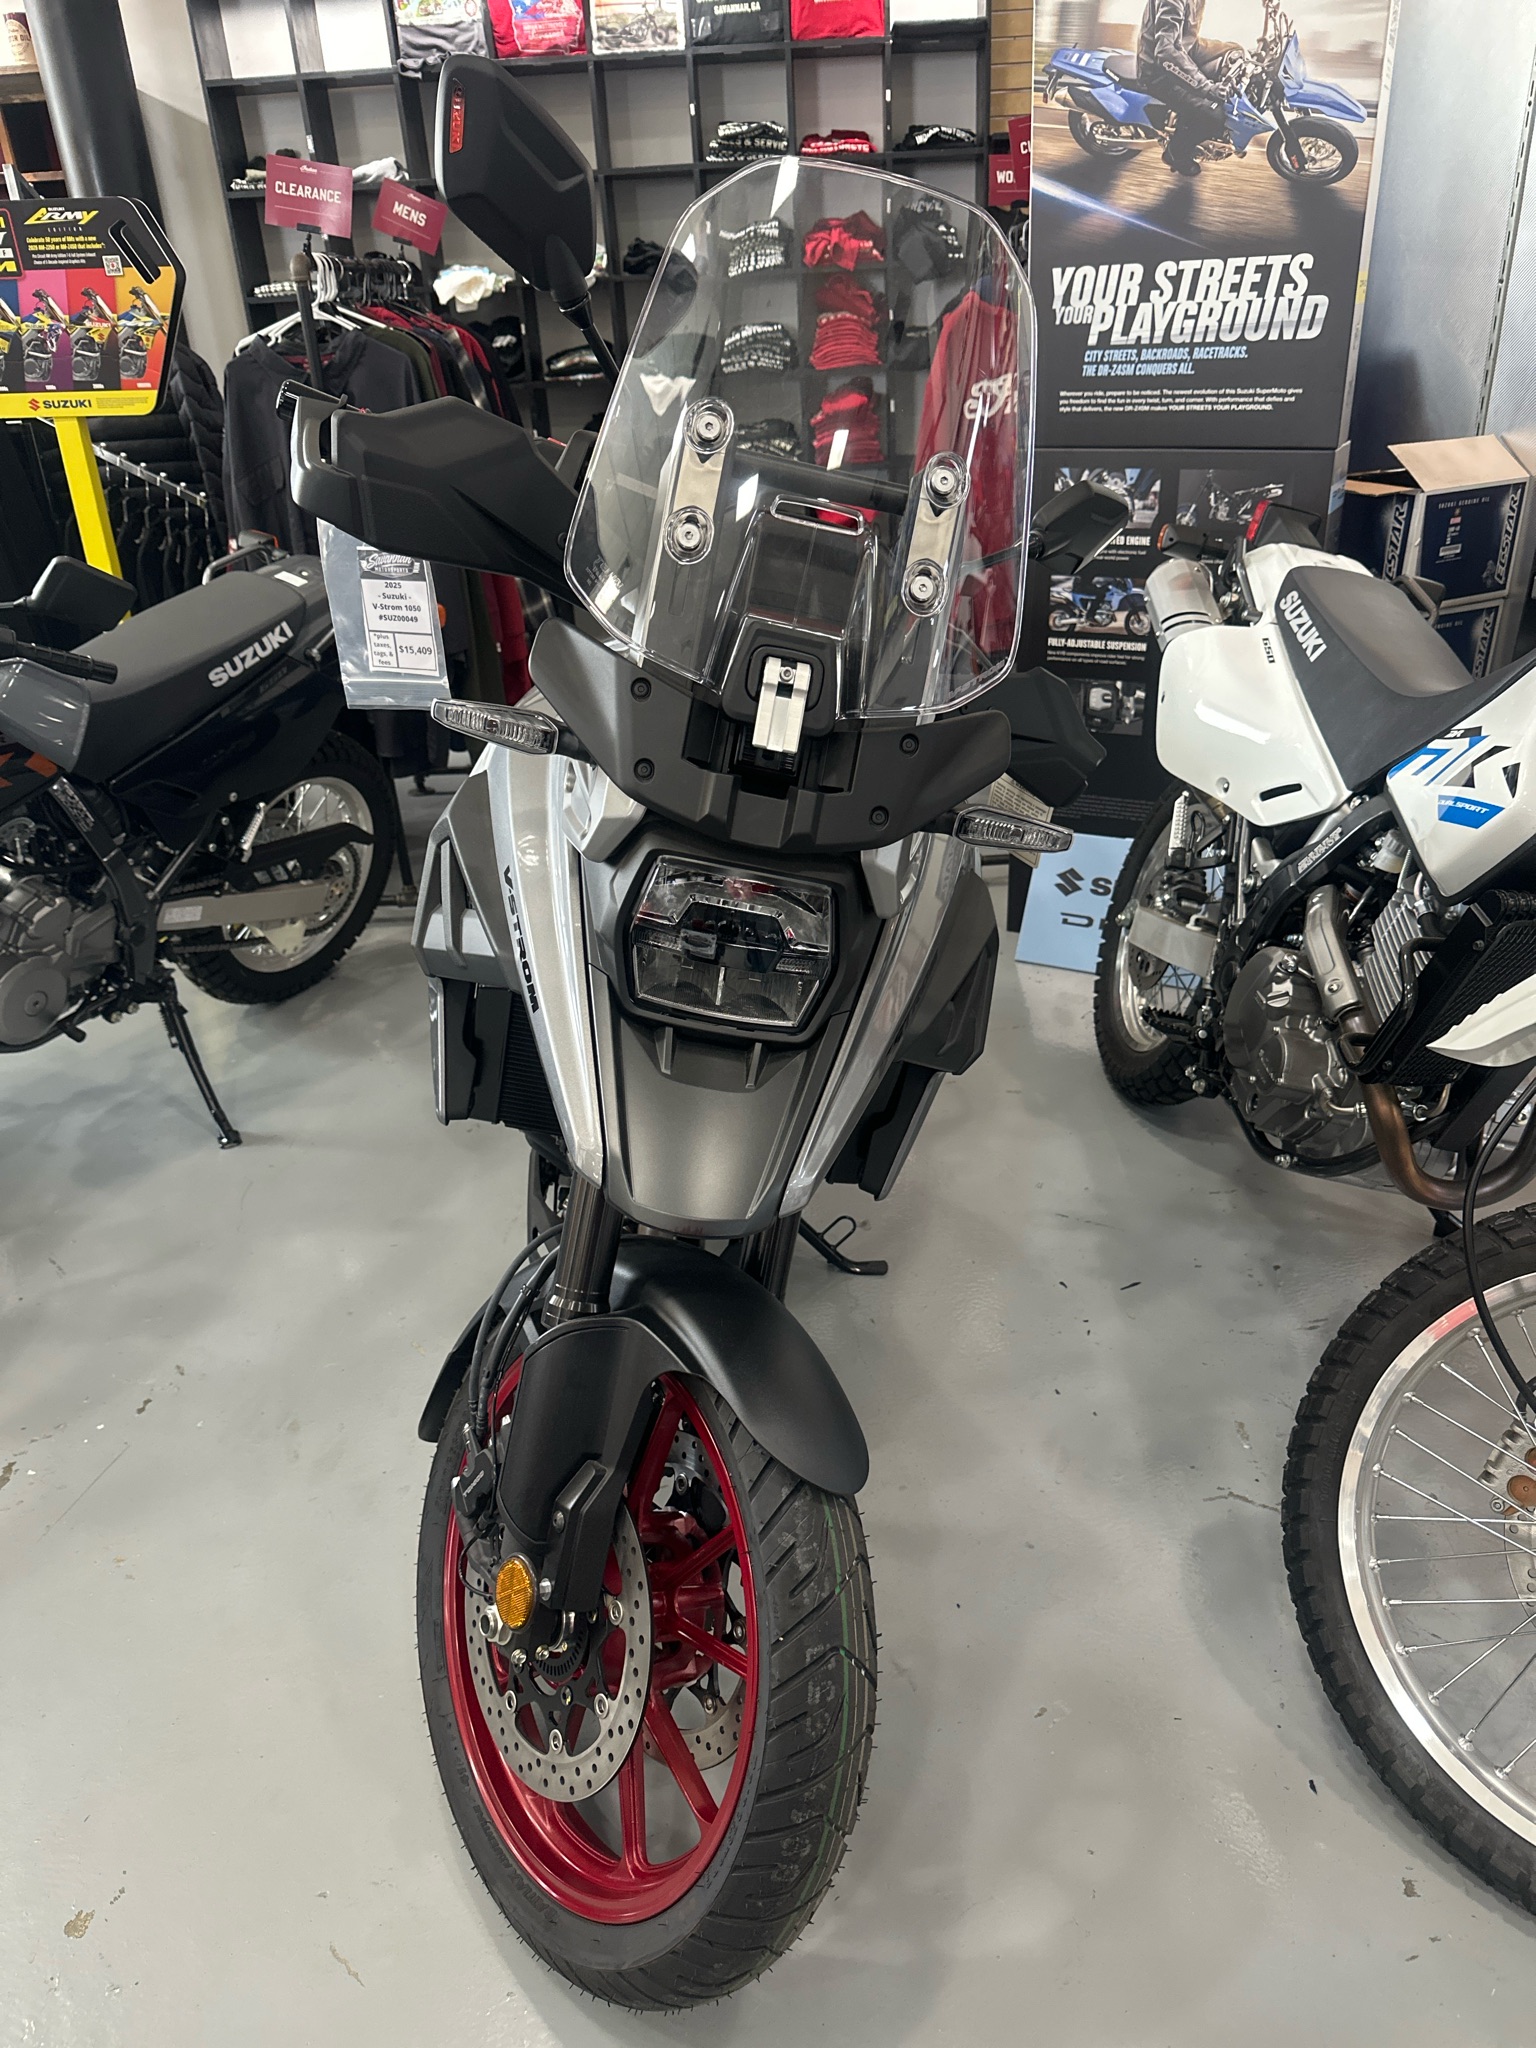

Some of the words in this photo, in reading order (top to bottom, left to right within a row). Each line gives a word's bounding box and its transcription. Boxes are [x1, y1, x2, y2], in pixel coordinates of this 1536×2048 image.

[275, 181, 341, 204] CLEARANCE
[392, 201, 427, 227] MENS
[1052, 262, 1144, 310] YOUR
[1150, 253, 1314, 307] STREETS
[1055, 305, 1094, 325] YOUR
[1087, 295, 1330, 346] PLAYGROUND
[1084, 350, 1102, 362] CITY
[1103, 349, 1139, 363] STREETS,
[1140, 347, 1190, 362] BACKROADS,
[1192, 346, 1248, 360] RACETRACKS.
[1082, 364, 1096, 377] THE
[1098, 363, 1135, 377] DR-Z4SM
[1135, 362, 1178, 376] CONQUERS
[1178, 362, 1195, 375] ALL.
[43, 399, 92, 409] SUZUKI
[1126, 536, 1151, 546] ENGINE
[372, 603, 402, 611] V-Strom
[404, 604, 421, 612] 1050
[379, 615, 418, 623] #SUZ00049
[1280, 590, 1327, 663] SUZUKI
[399, 645, 432, 656] $15,409
[1048, 637, 1106, 650] FULLY-ADJUSTABLE
[1106, 641, 1147, 652] SUSPENSION
[1262, 638, 1275, 663] 650
[208, 621, 294, 688] SUZUKI
[374, 650, 389, 658] tags,
[1089, 877, 1113, 896] S
[504, 865, 539, 1013] V-STROM
